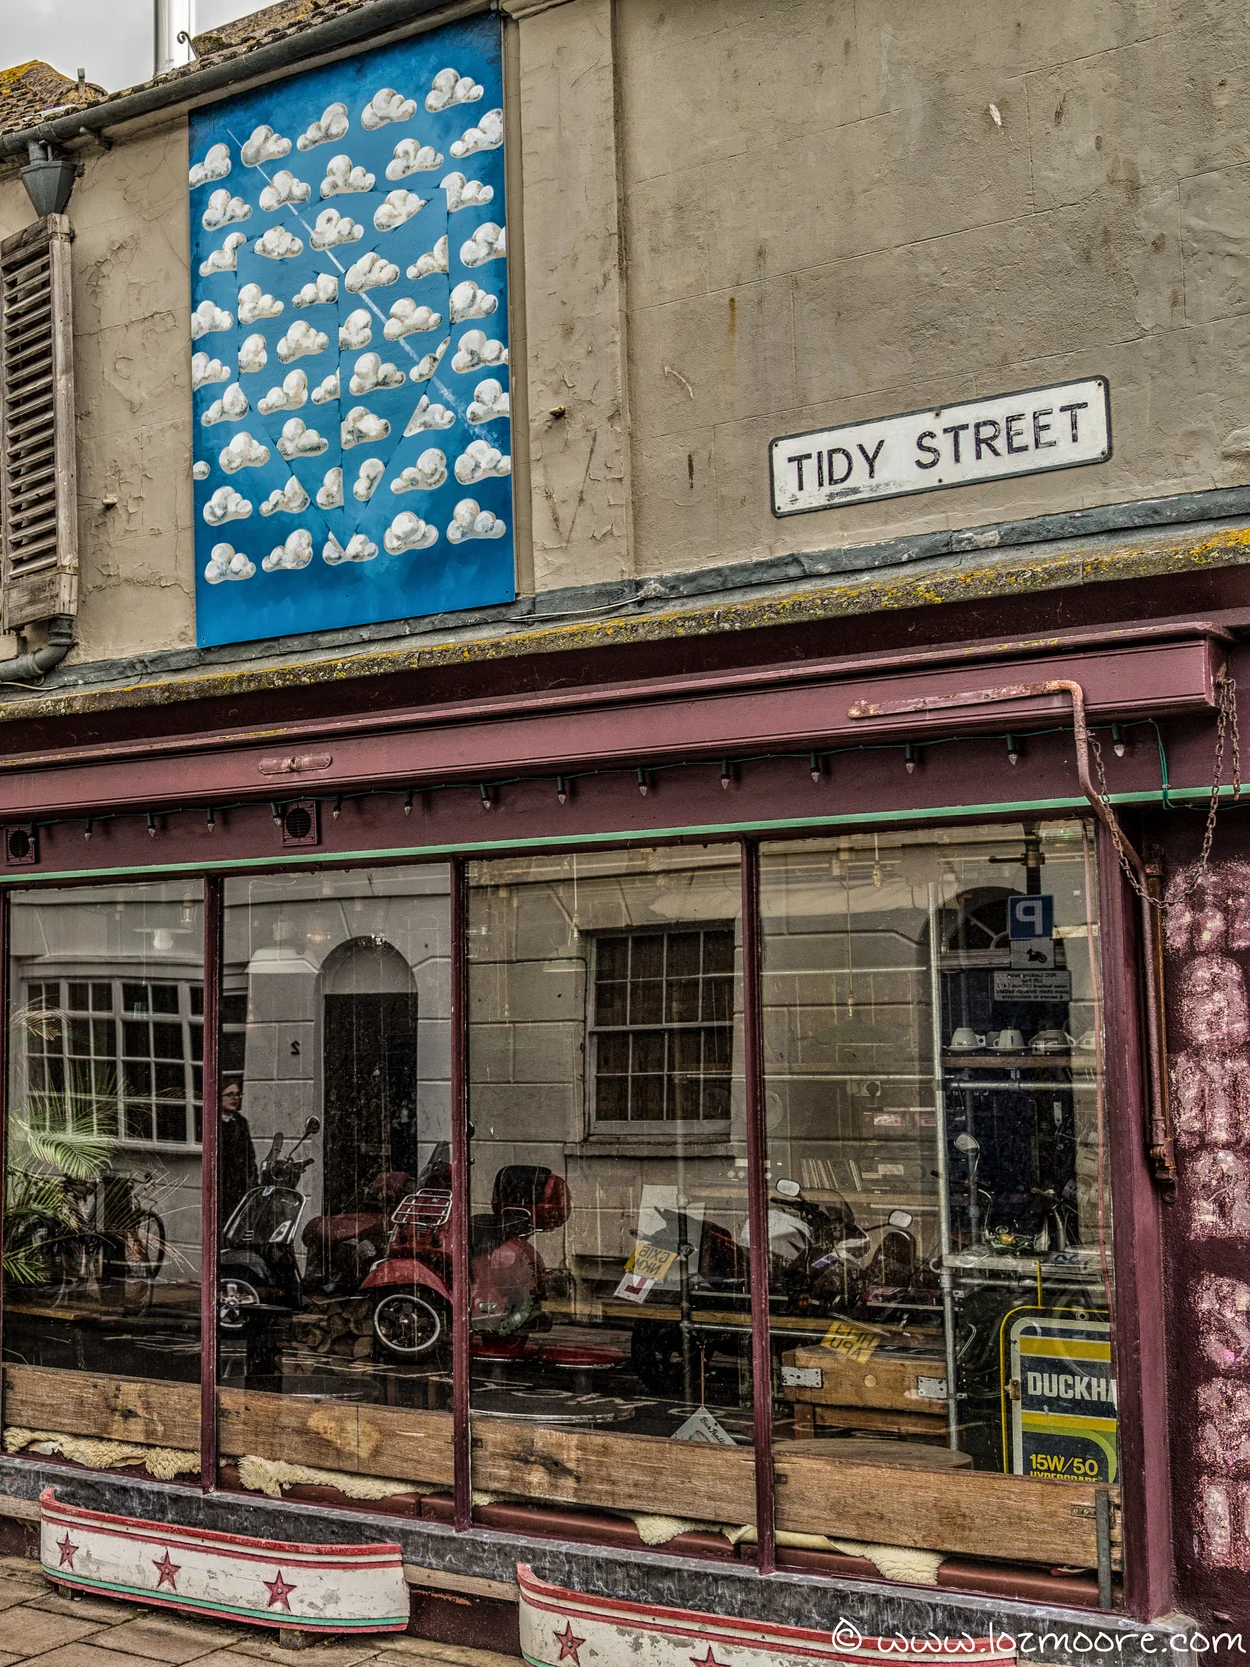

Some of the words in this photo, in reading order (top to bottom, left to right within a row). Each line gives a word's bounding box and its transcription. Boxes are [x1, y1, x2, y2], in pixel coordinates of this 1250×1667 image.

[787, 439, 885, 491] TIDY
[914, 401, 1089, 470] STREET
[1029, 1453, 1100, 1476] 15W/50
